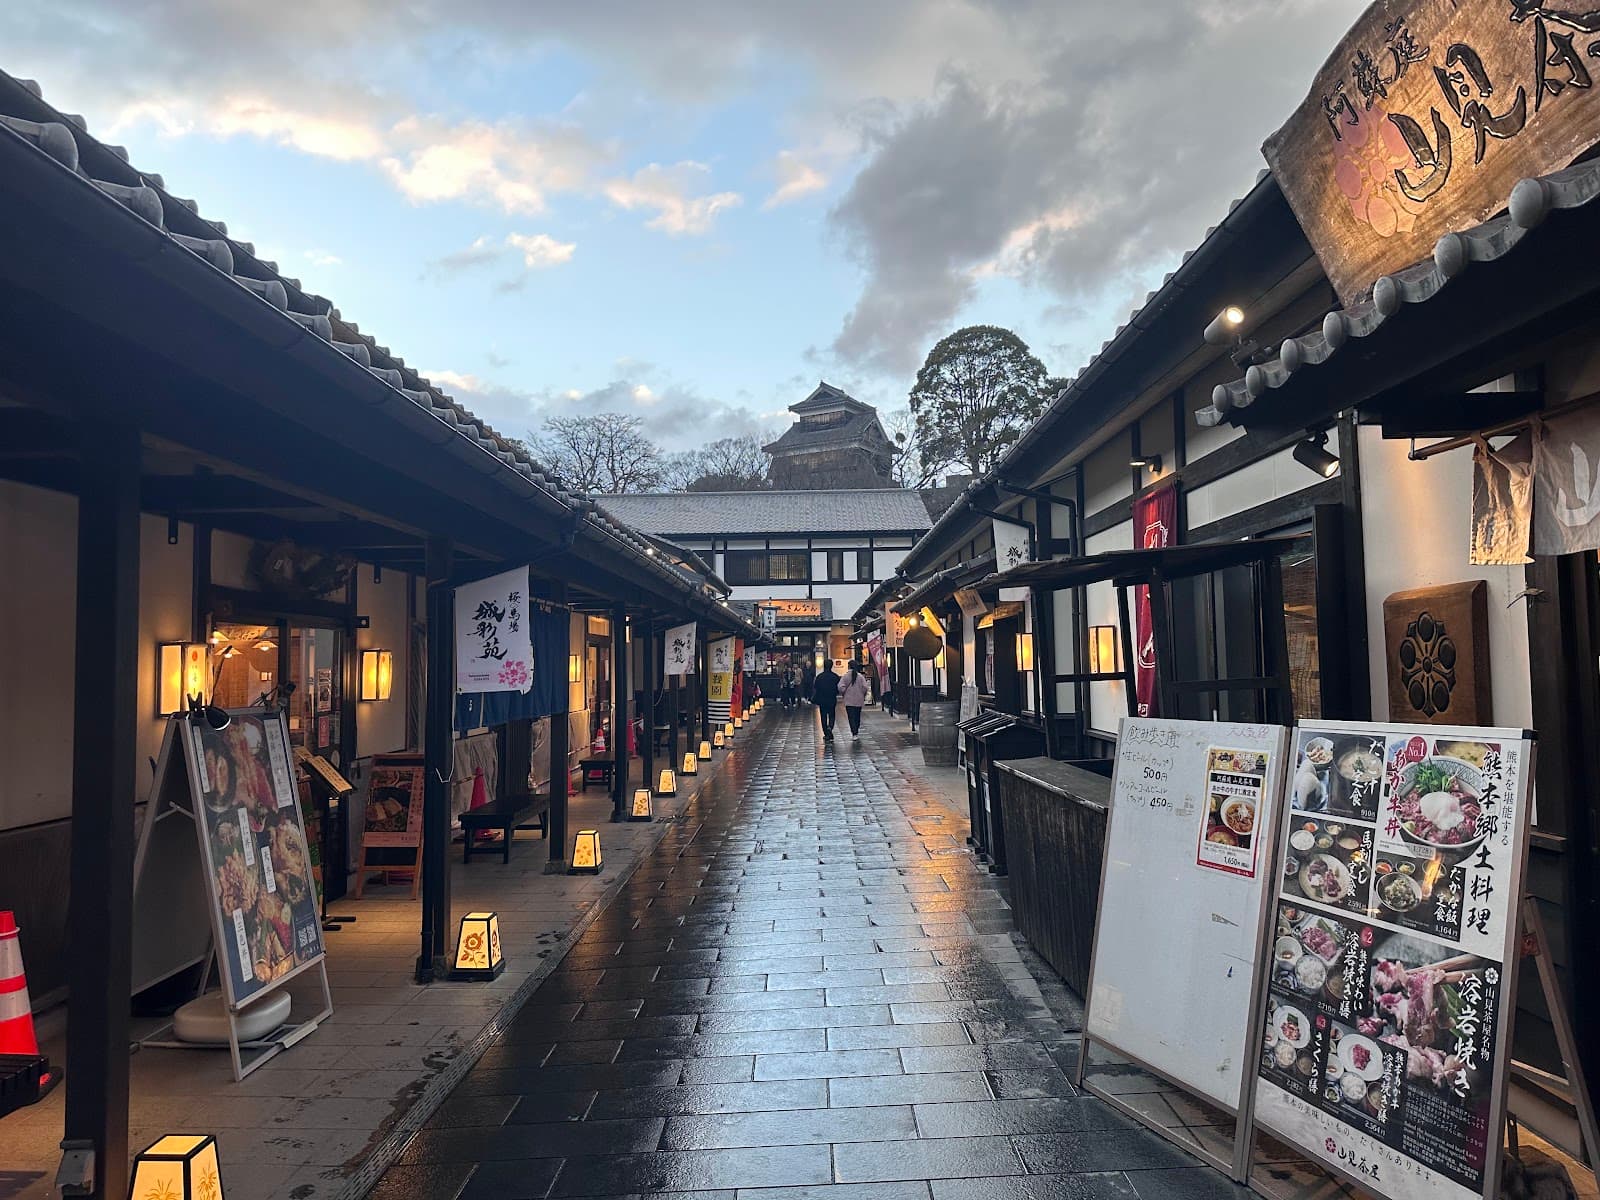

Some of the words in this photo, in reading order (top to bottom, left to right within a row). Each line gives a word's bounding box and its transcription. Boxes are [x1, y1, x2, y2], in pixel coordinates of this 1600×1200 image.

[465, 600, 508, 660] 城彩苑
[508, 591, 521, 634] 桜の馬場
[1143, 766, 1168, 783] 500円
[1150, 796, 1174, 812] 450円
[1384, 749, 1407, 839] あか牛丼
[1501, 751, 1518, 846] 熊本を堪能する
[1466, 752, 1502, 935] 熊本郷土料理
[1445, 867, 1462, 925] たかな飯
[1367, 931, 1373, 944] 2
[1453, 972, 1483, 1098] 溶岩焼き
[1480, 986, 1495, 1062] 山見茶屋名物
